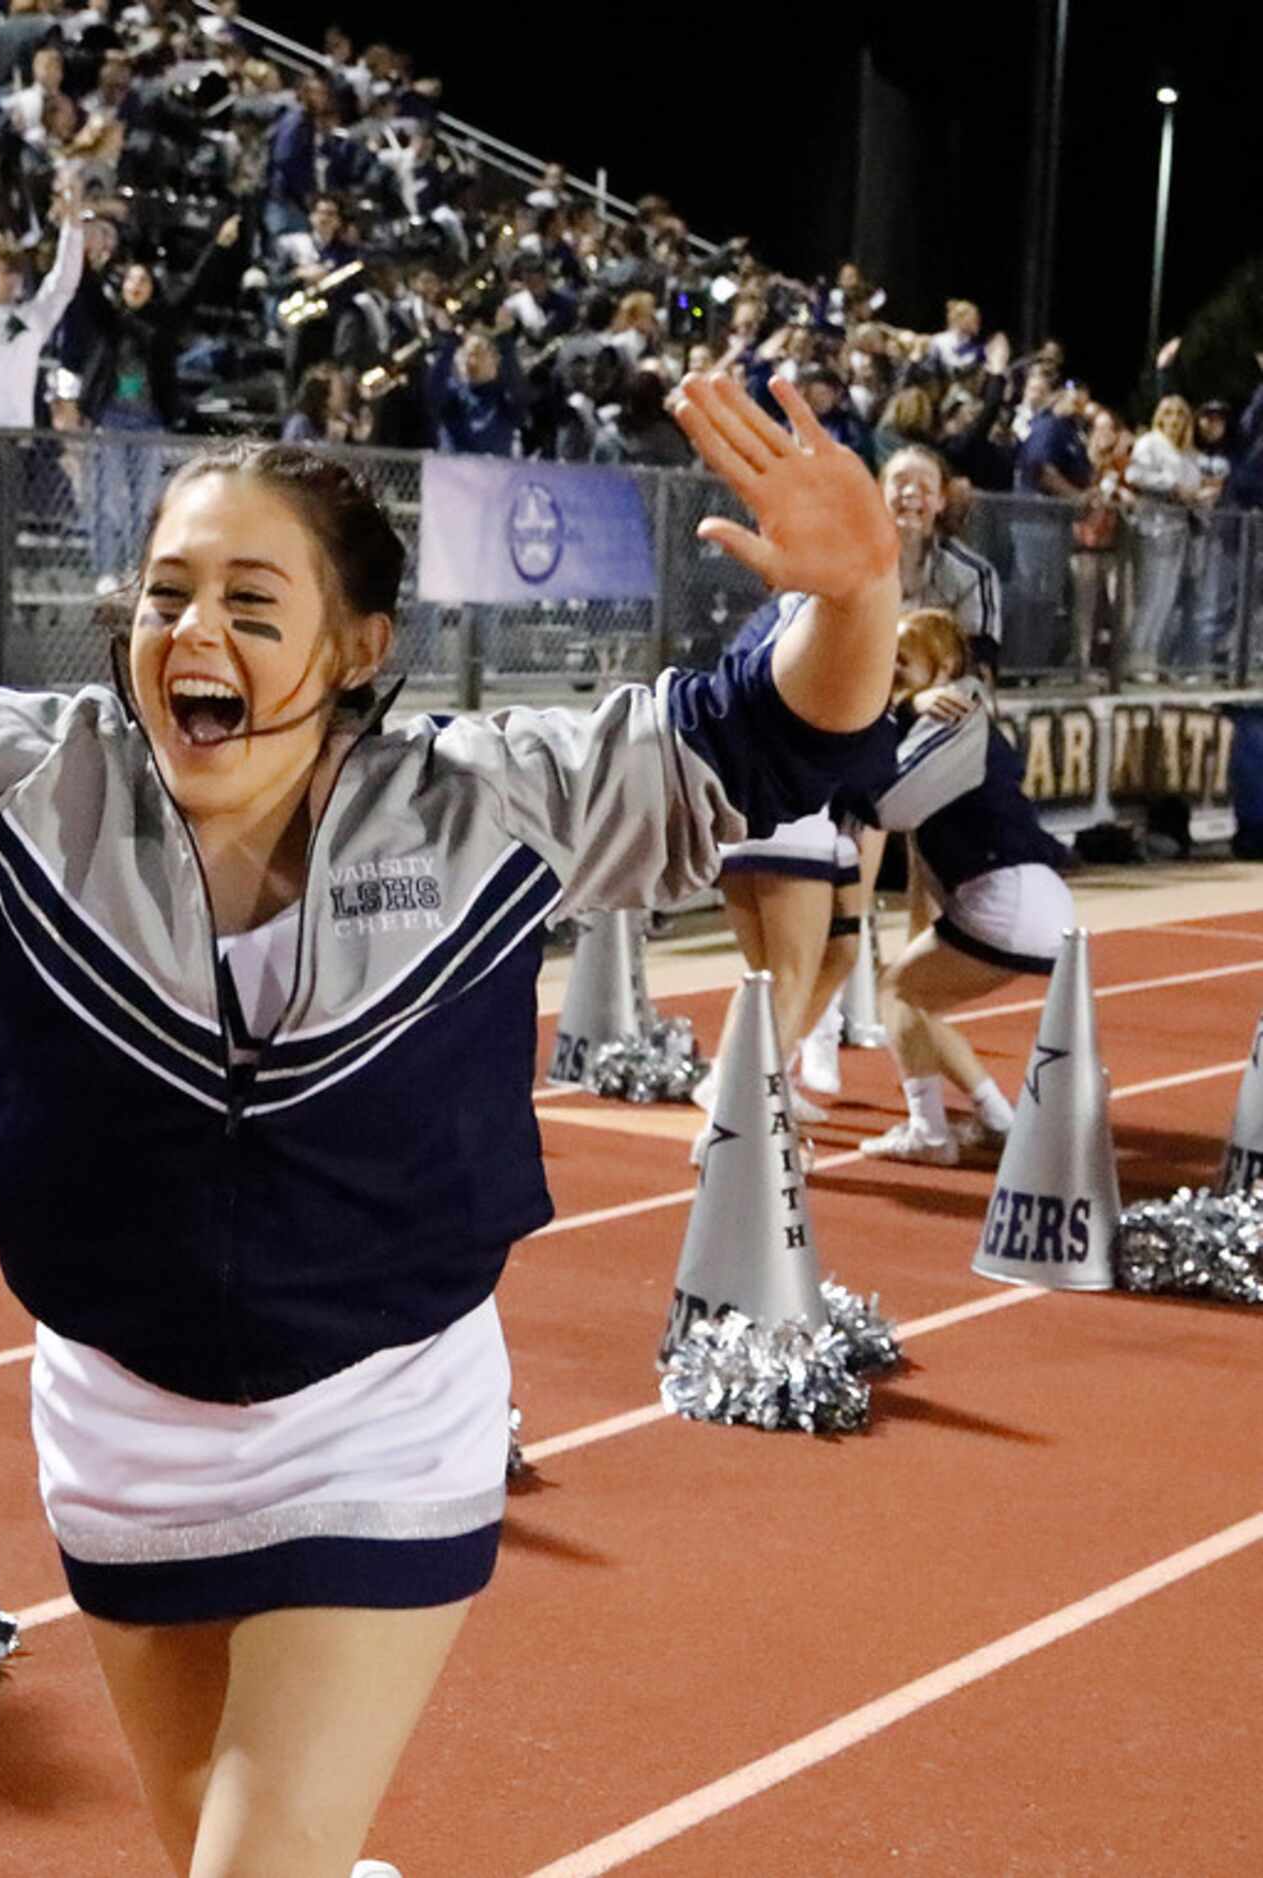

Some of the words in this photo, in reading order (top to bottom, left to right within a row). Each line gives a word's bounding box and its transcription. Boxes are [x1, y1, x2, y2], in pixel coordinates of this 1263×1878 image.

[328, 858, 434, 883] VARSITY
[329, 875, 442, 919] LSHS
[335, 912, 443, 938] CHEER
[766, 1073, 806, 1250] FAITH
[984, 1187, 1091, 1264] GERS
